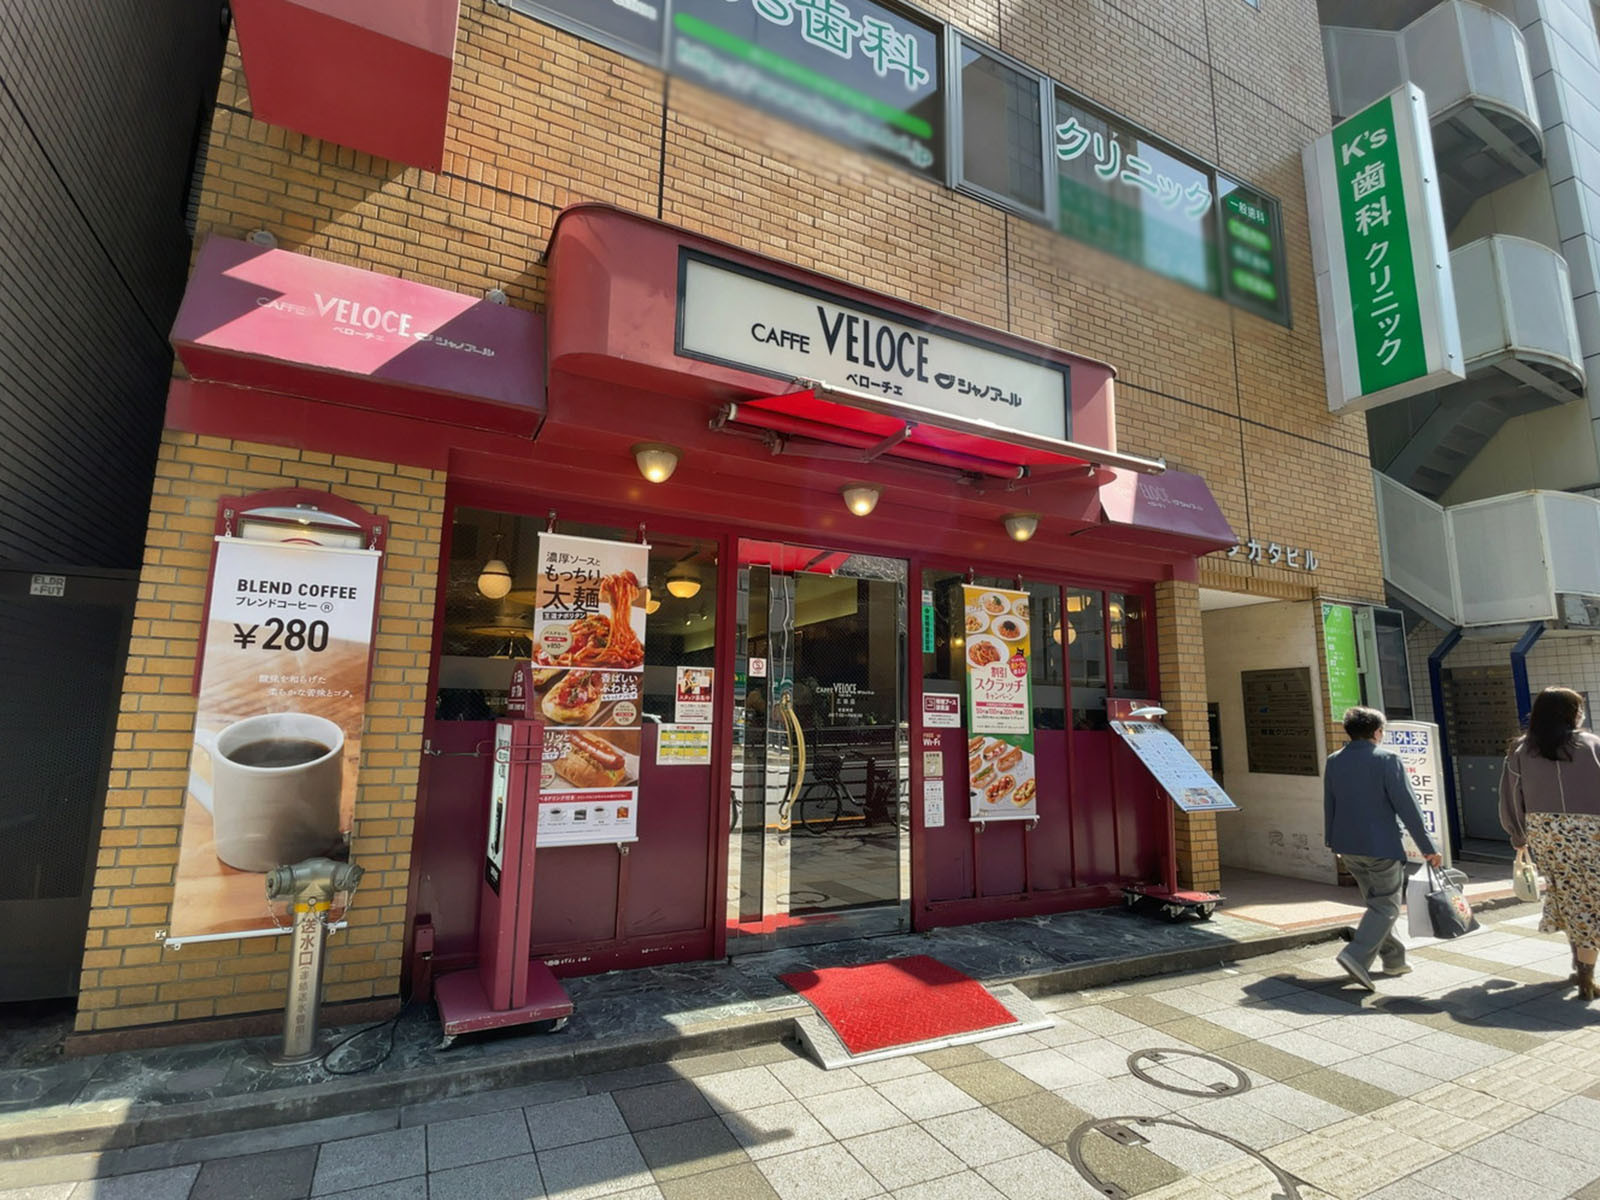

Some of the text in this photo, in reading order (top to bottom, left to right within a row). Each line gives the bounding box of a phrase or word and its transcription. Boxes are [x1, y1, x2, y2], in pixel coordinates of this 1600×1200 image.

[1341, 127, 1388, 166] K's
[1056, 117, 1212, 220] クリニック
[256, 293, 413, 338] CAFFE VELOCE
[333, 326, 385, 342] ベローチェ
[751, 305, 929, 384] CAFFE VELOCE
[846, 373, 903, 396] ベローチェ
[957, 377, 1022, 407] シャノアール
[1139, 482, 1170, 504] ELOCE
[546, 552, 600, 567] 濃厚ソースと
[545, 564, 600, 586] もっちり
[237, 578, 357, 600] BLEND COFFEE
[542, 584, 600, 613] 太麺
[235, 597, 318, 611] ブレンドコーヒー
[233, 617, 330, 652] ¥280
[975, 677, 1024, 693] スクラッチ
[544, 731, 570, 742] リッと
[1411, 776, 1431, 787] 3F
[298, 919, 317, 967] 送水口
